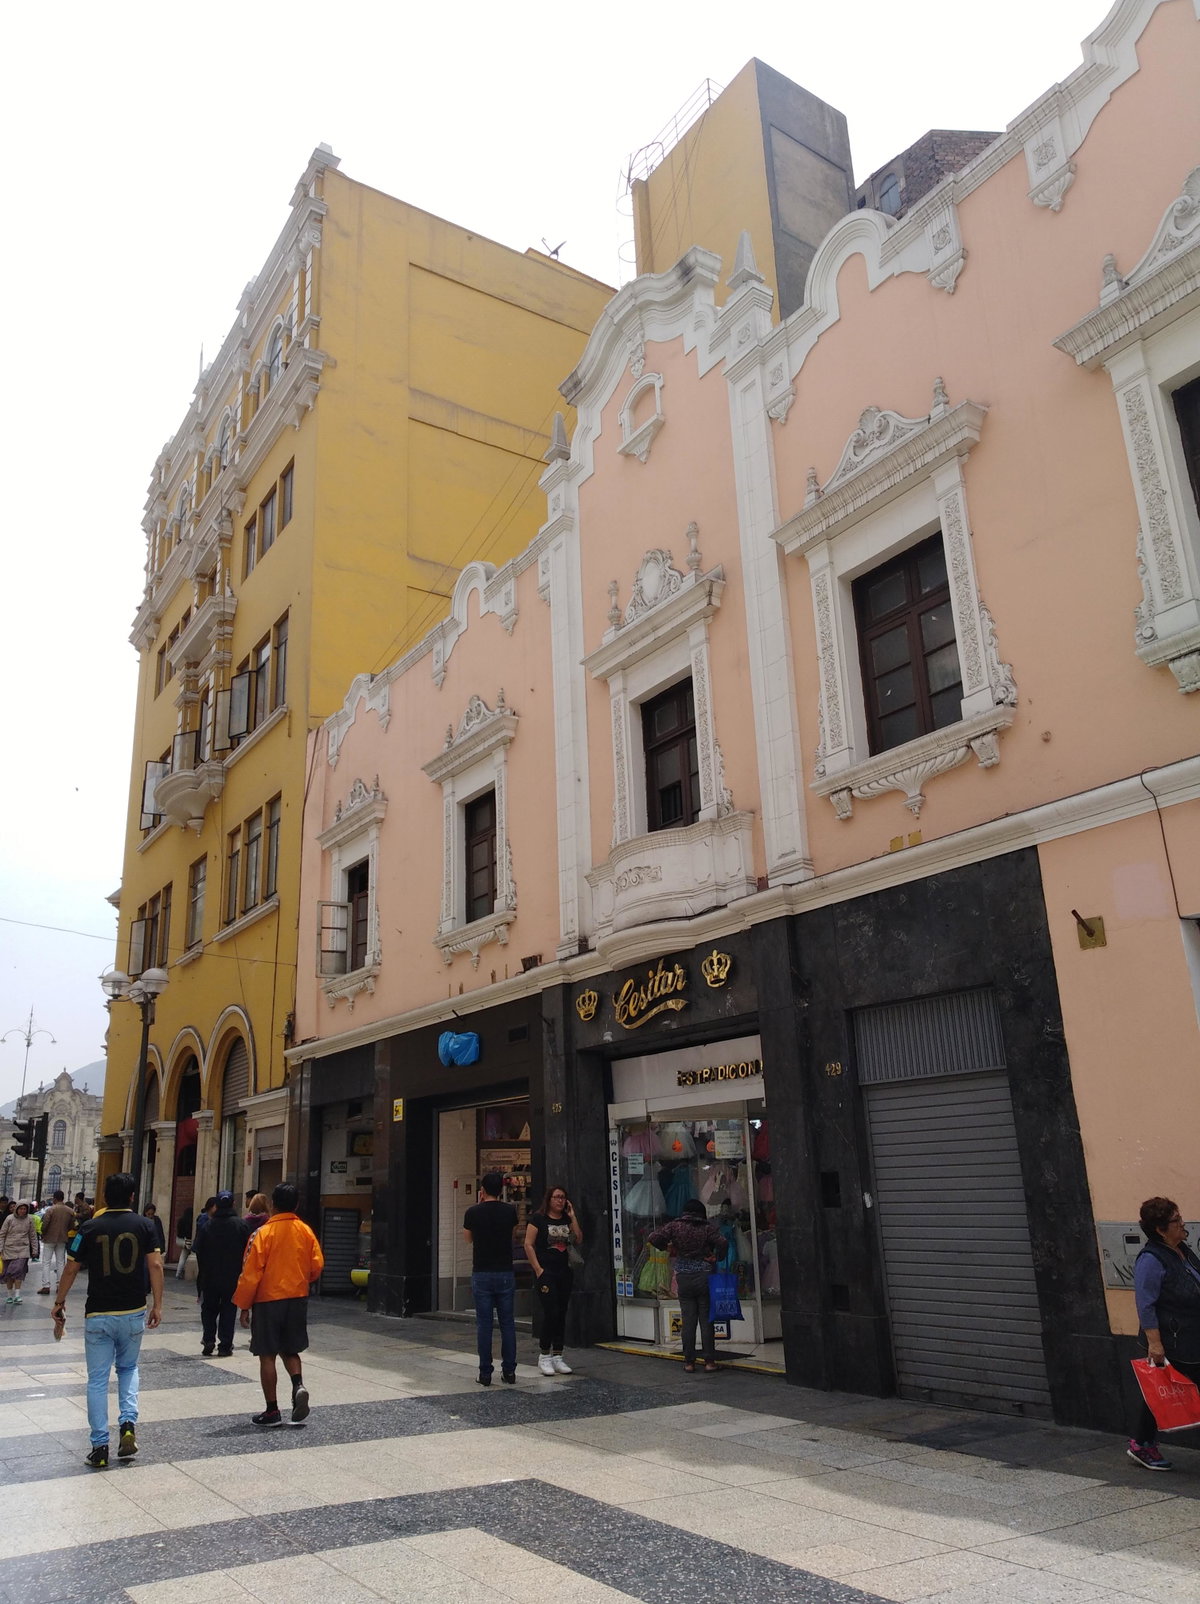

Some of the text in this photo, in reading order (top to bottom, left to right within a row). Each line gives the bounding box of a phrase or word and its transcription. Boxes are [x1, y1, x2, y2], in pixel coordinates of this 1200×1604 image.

[612, 958, 687, 1029] Cesitar
[611, 1151, 621, 1248] CESITAR
[96, 1232, 139, 1276] 10
